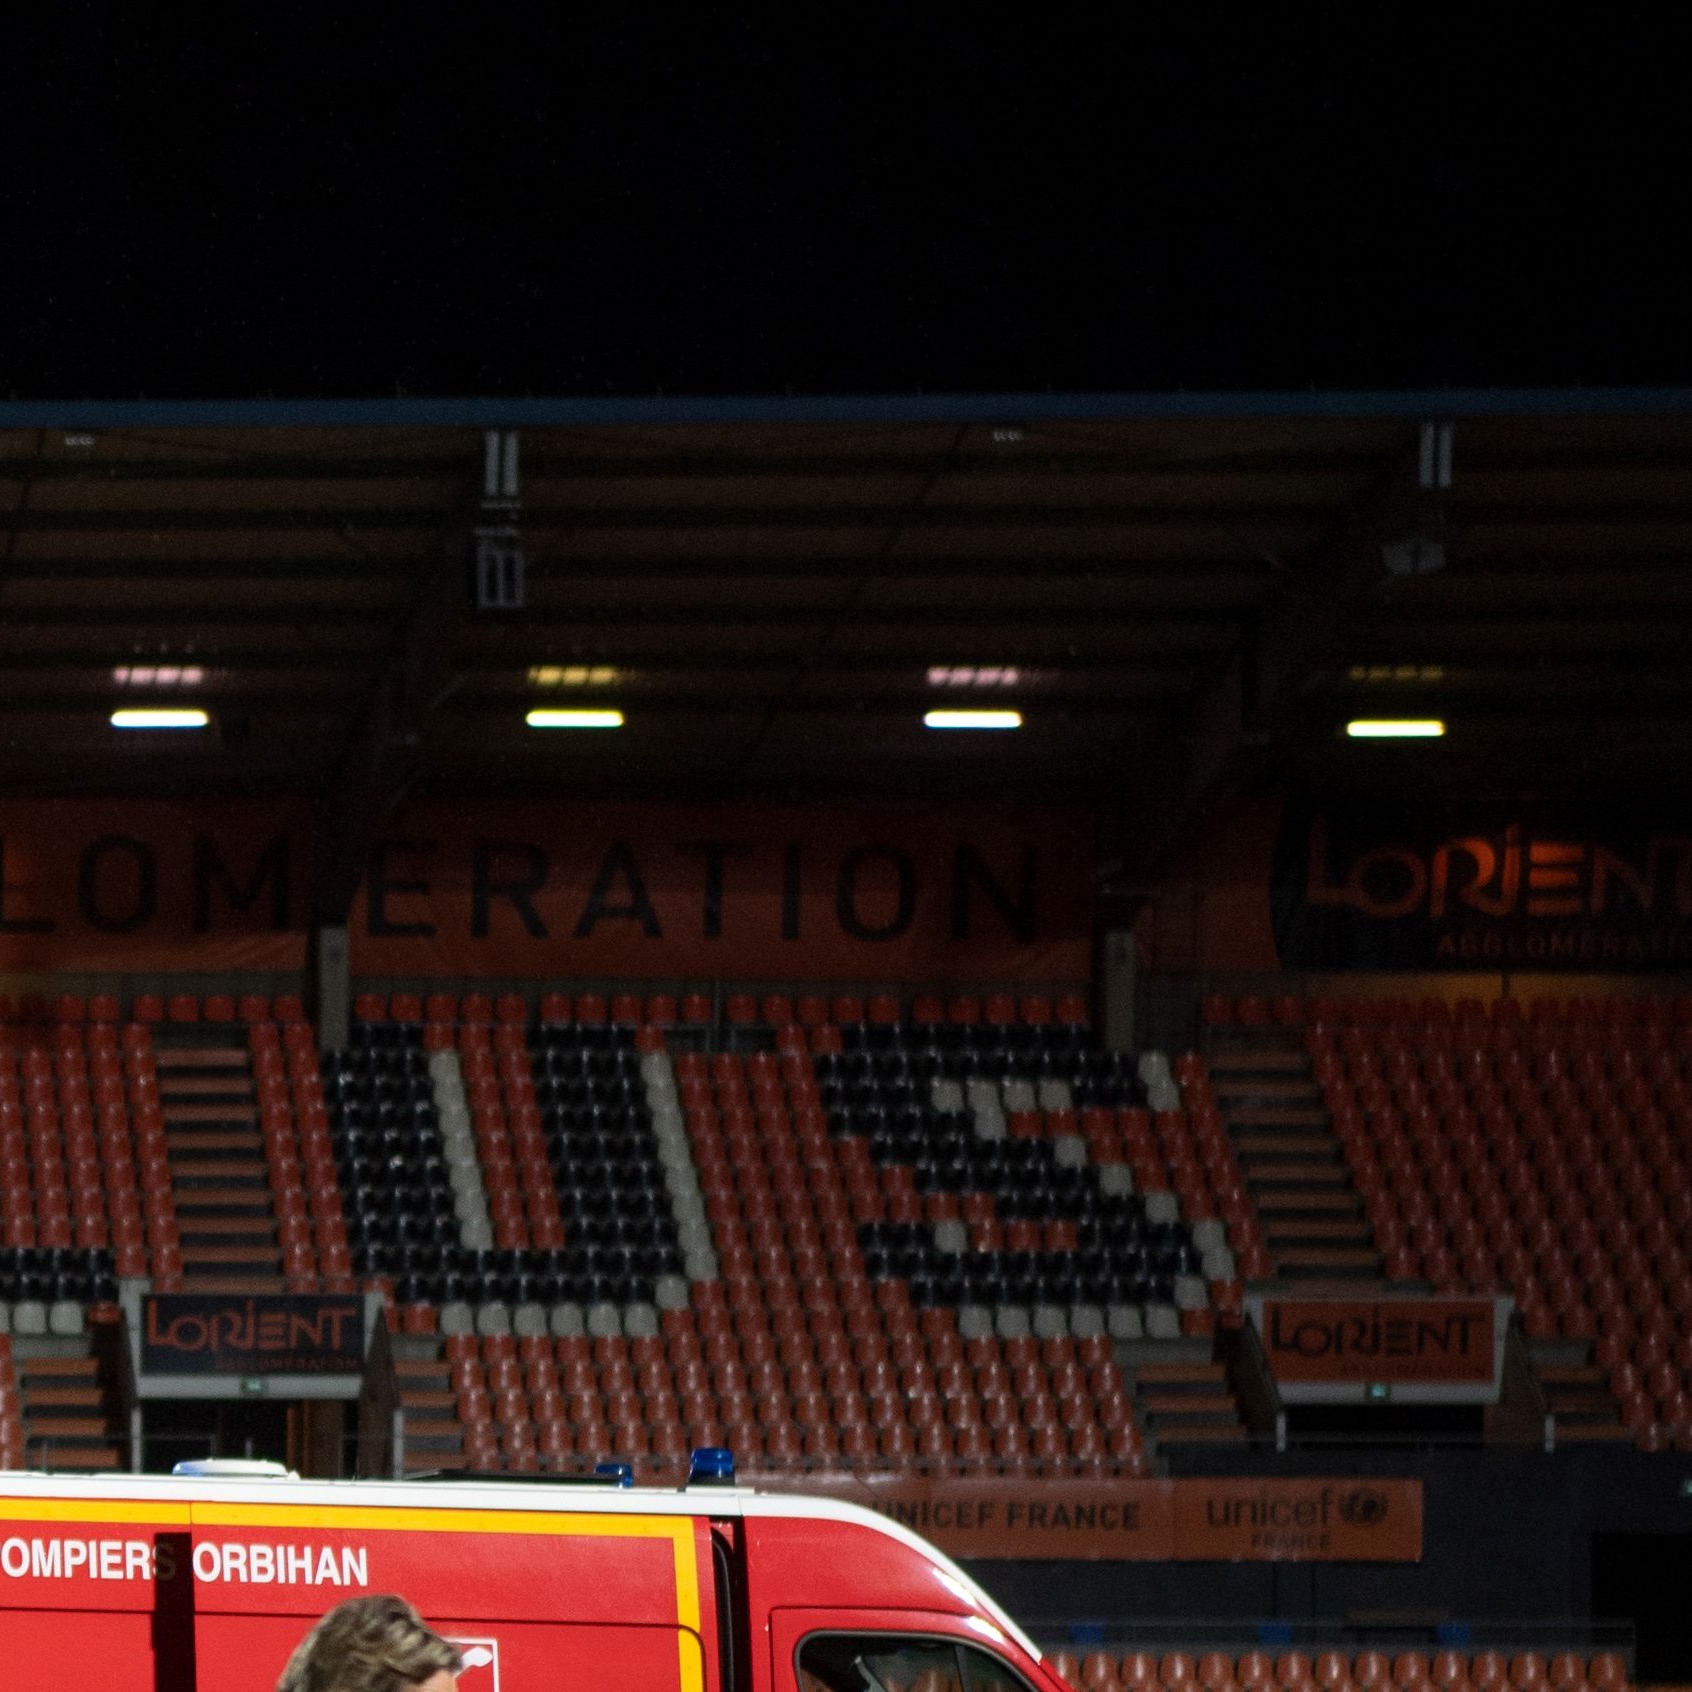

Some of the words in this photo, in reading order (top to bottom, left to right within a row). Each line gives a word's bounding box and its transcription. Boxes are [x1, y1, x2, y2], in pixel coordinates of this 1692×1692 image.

[145, 1298, 356, 1352] LORIENT
[1271, 1305, 1486, 1357] LORIENT
[1007, 1502, 1141, 1531] FRANCE
[1206, 1488, 1332, 1528] unicef
[1251, 1532, 1331, 1550] FRANCE
